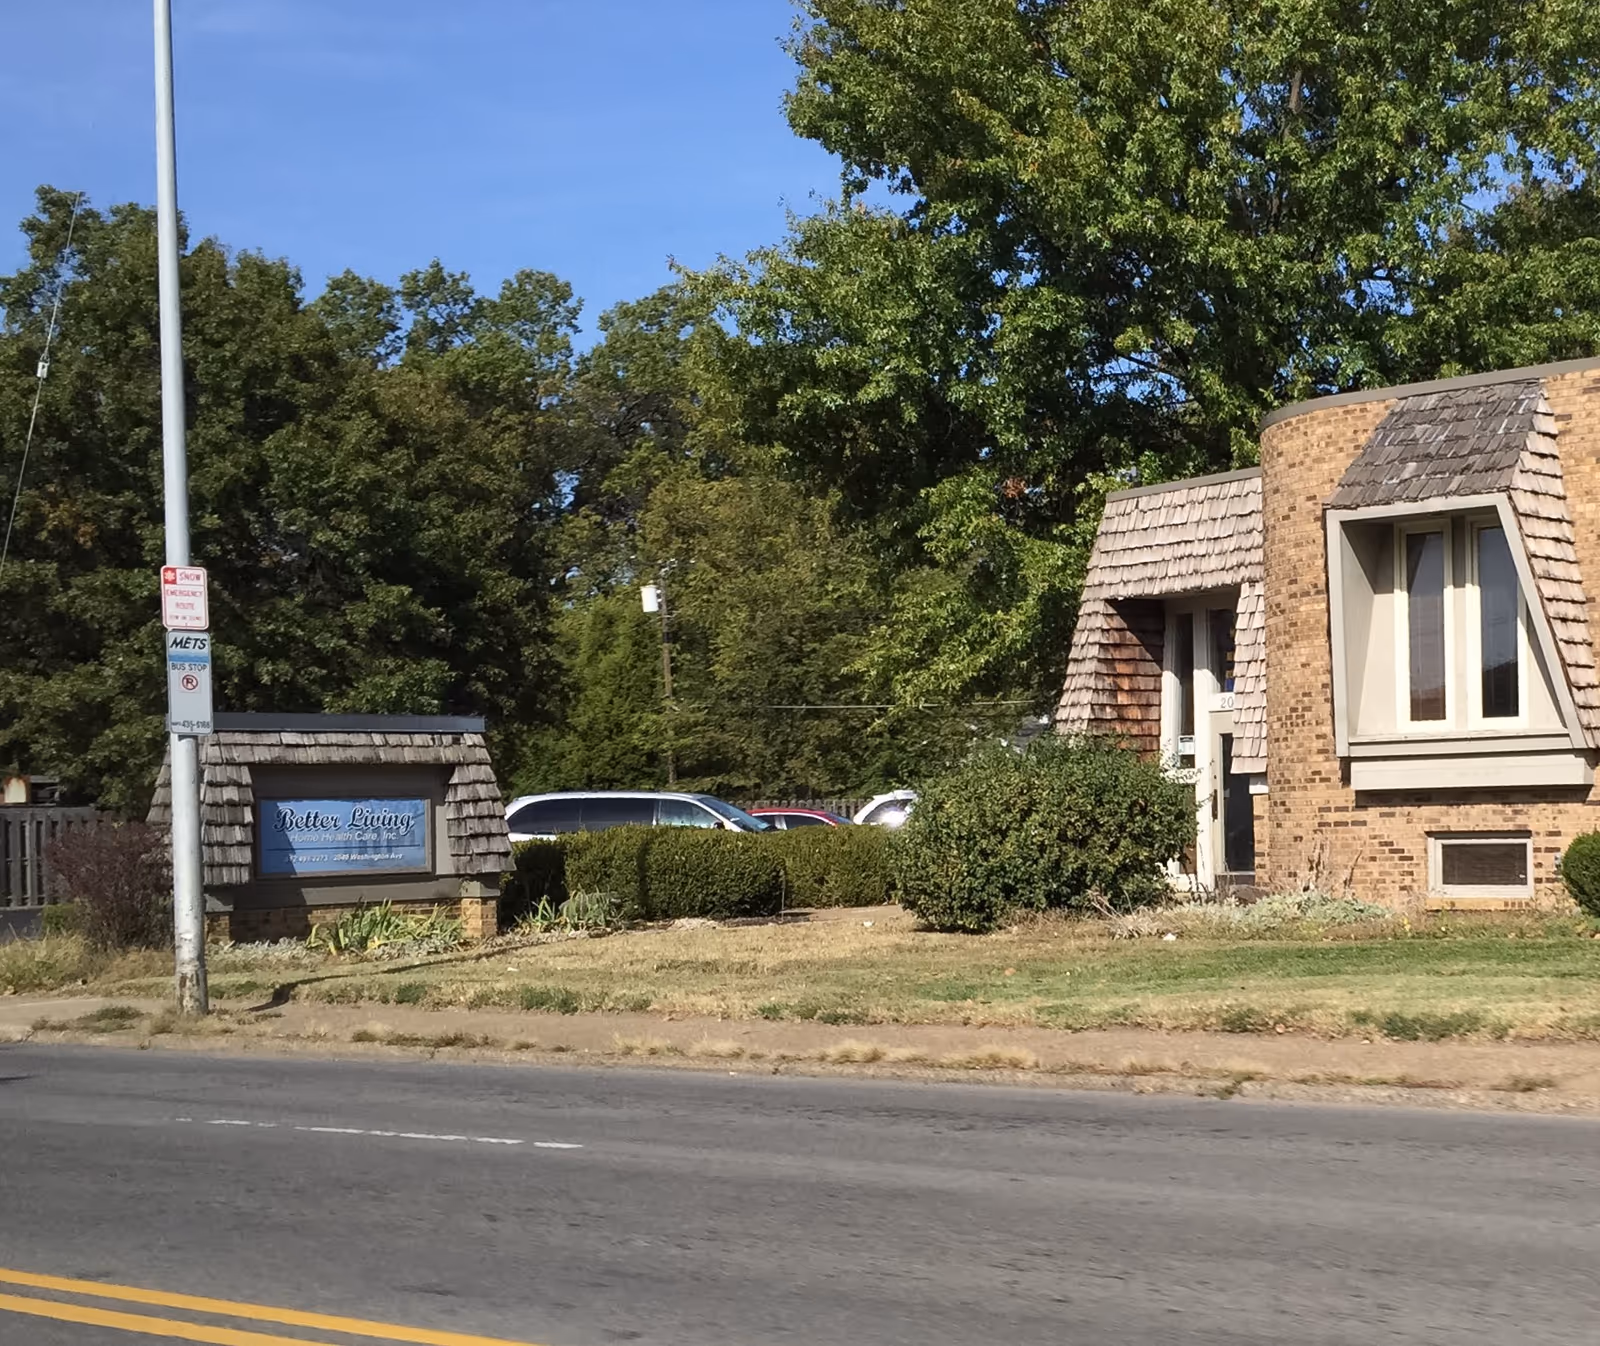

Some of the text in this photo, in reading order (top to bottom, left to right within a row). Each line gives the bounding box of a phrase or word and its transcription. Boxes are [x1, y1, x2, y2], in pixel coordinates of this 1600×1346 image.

[179, 573, 201, 581] SNOW
[170, 636, 207, 650] METS
[171, 663, 208, 672] BUS STOP
[273, 806, 415, 837] Better Living
[290, 832, 319, 843] Home
[321, 831, 353, 843] Health
[354, 831, 380, 842] Care,
